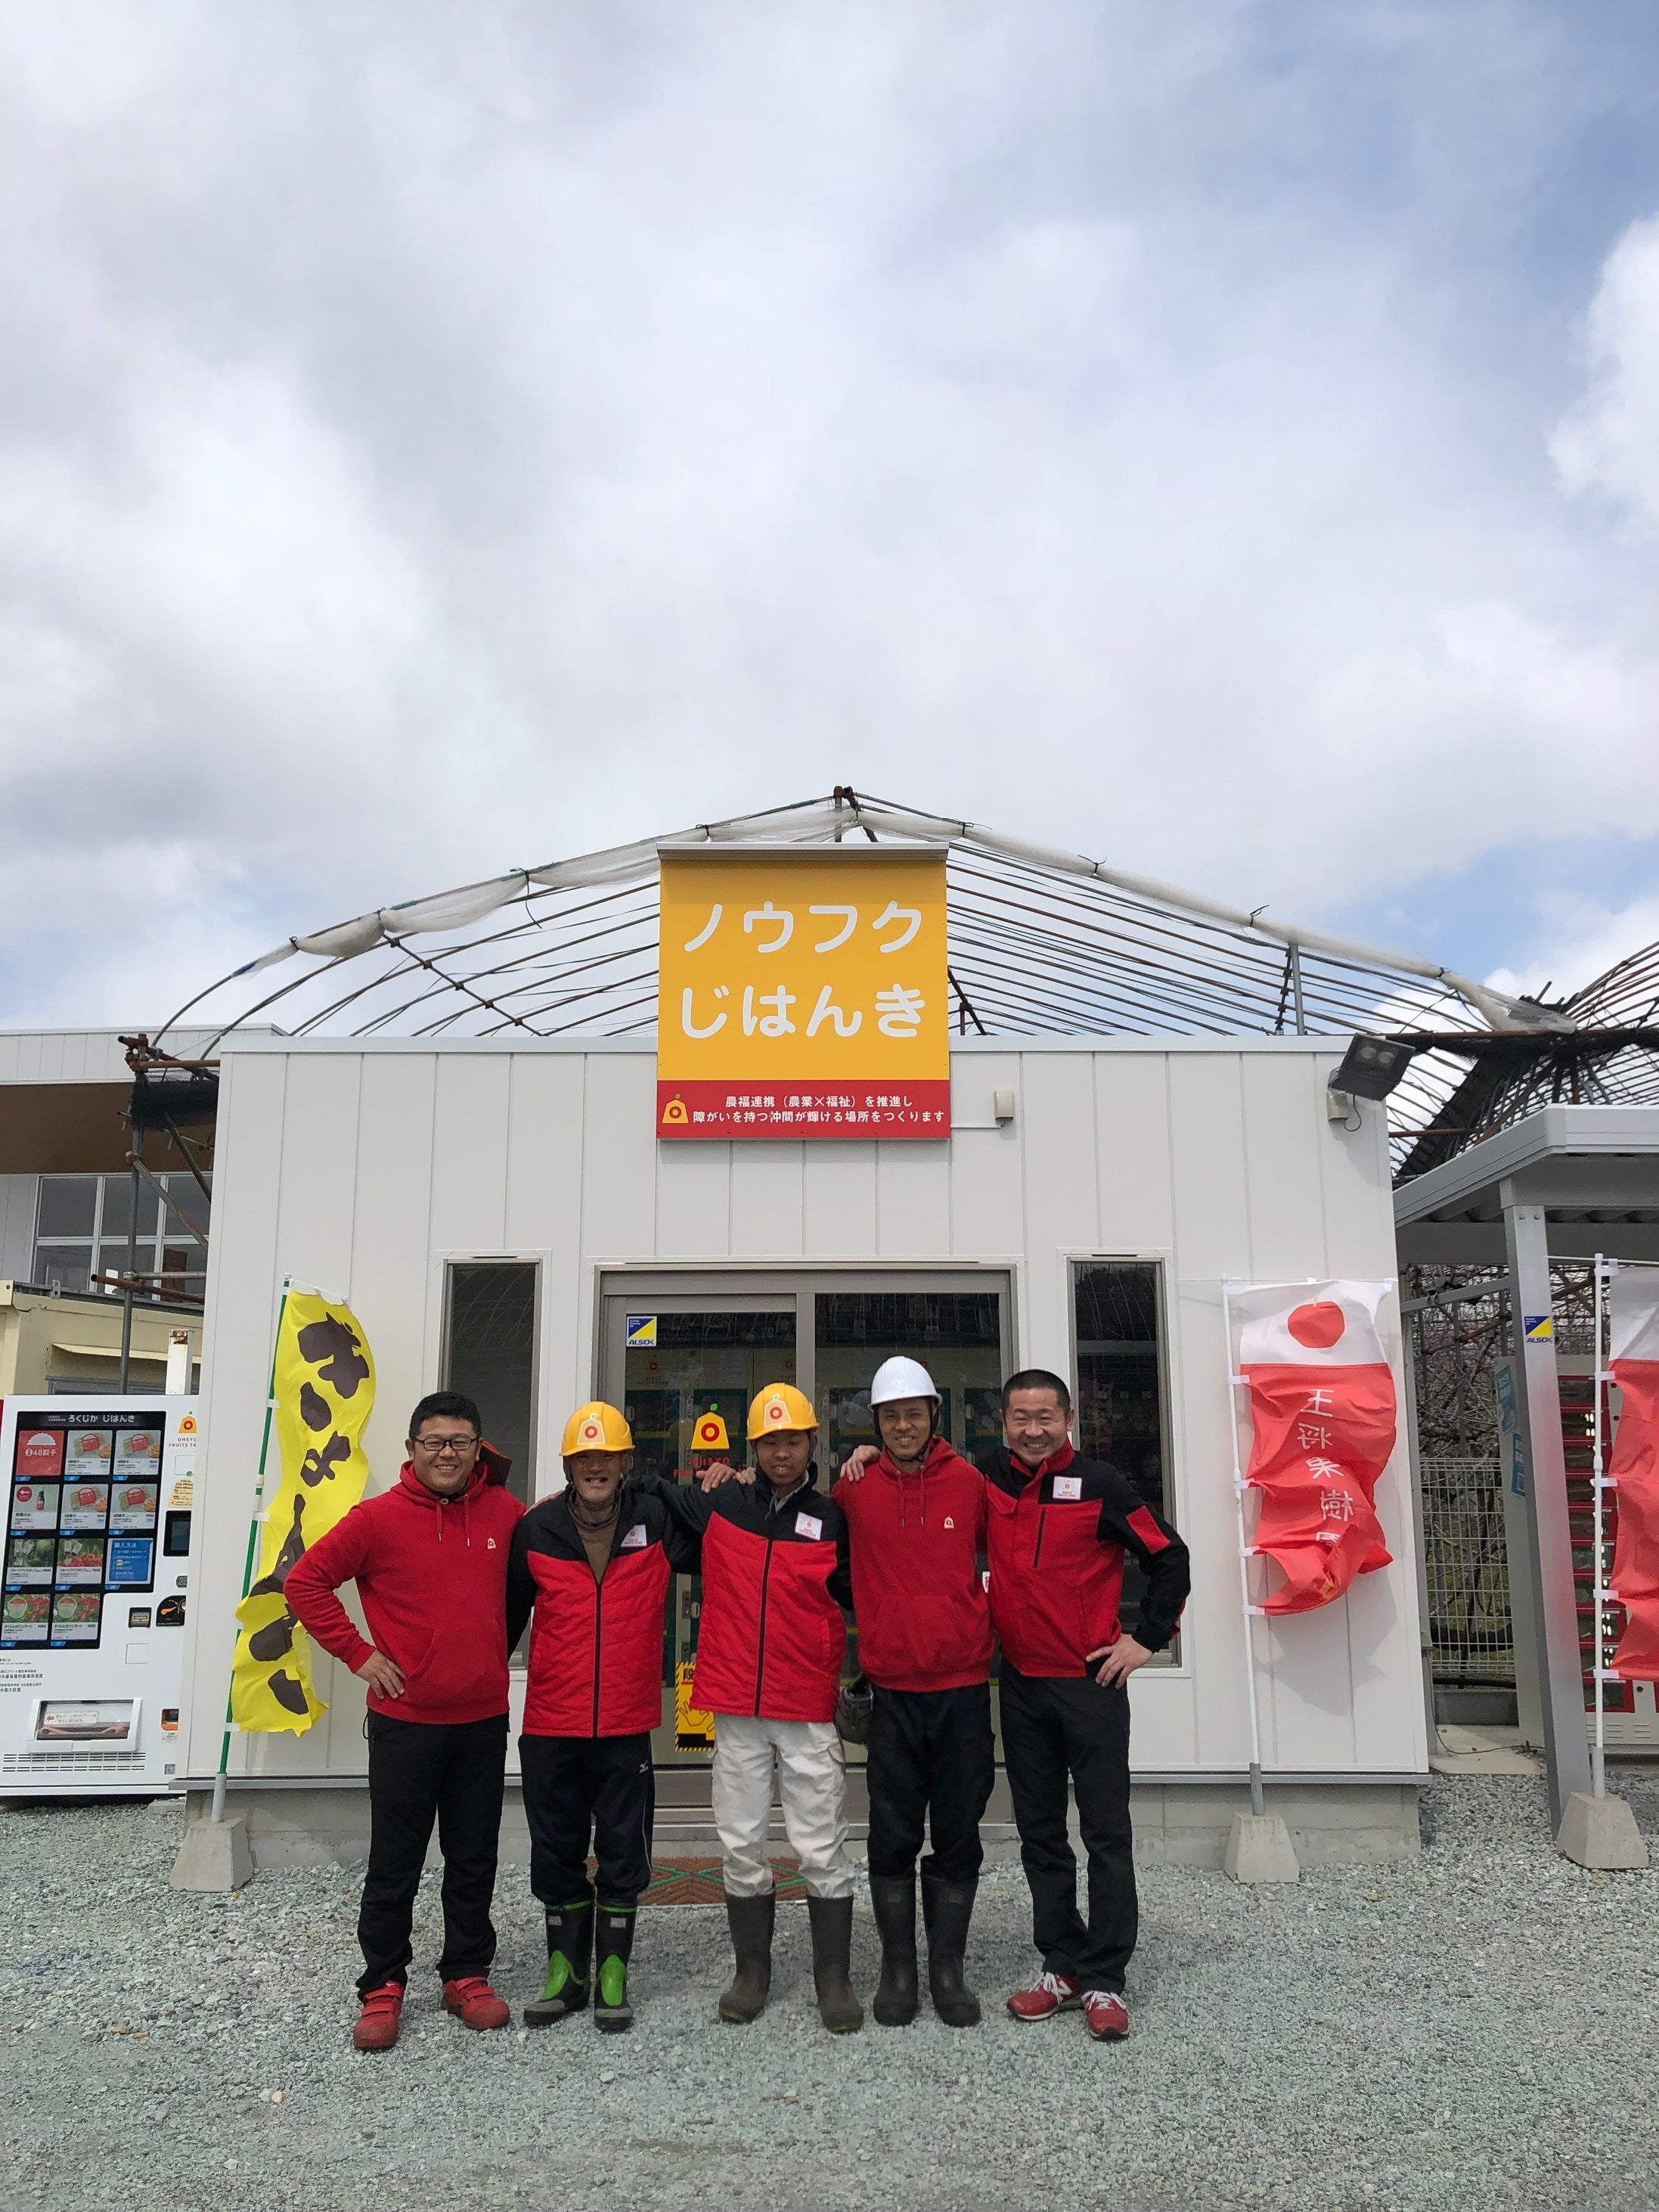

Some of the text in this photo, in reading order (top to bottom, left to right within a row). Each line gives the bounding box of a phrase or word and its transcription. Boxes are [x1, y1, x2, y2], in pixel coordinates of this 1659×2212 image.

[684, 901, 922, 953] ノウフク
[681, 984, 926, 1038] じはんき
[693, 1110, 945, 1124] 障がいを持つ仲間が輝ける場所をつくります
[68, 1414, 98, 1422] ろくじか
[103, 1414, 135, 1422] じはんき
